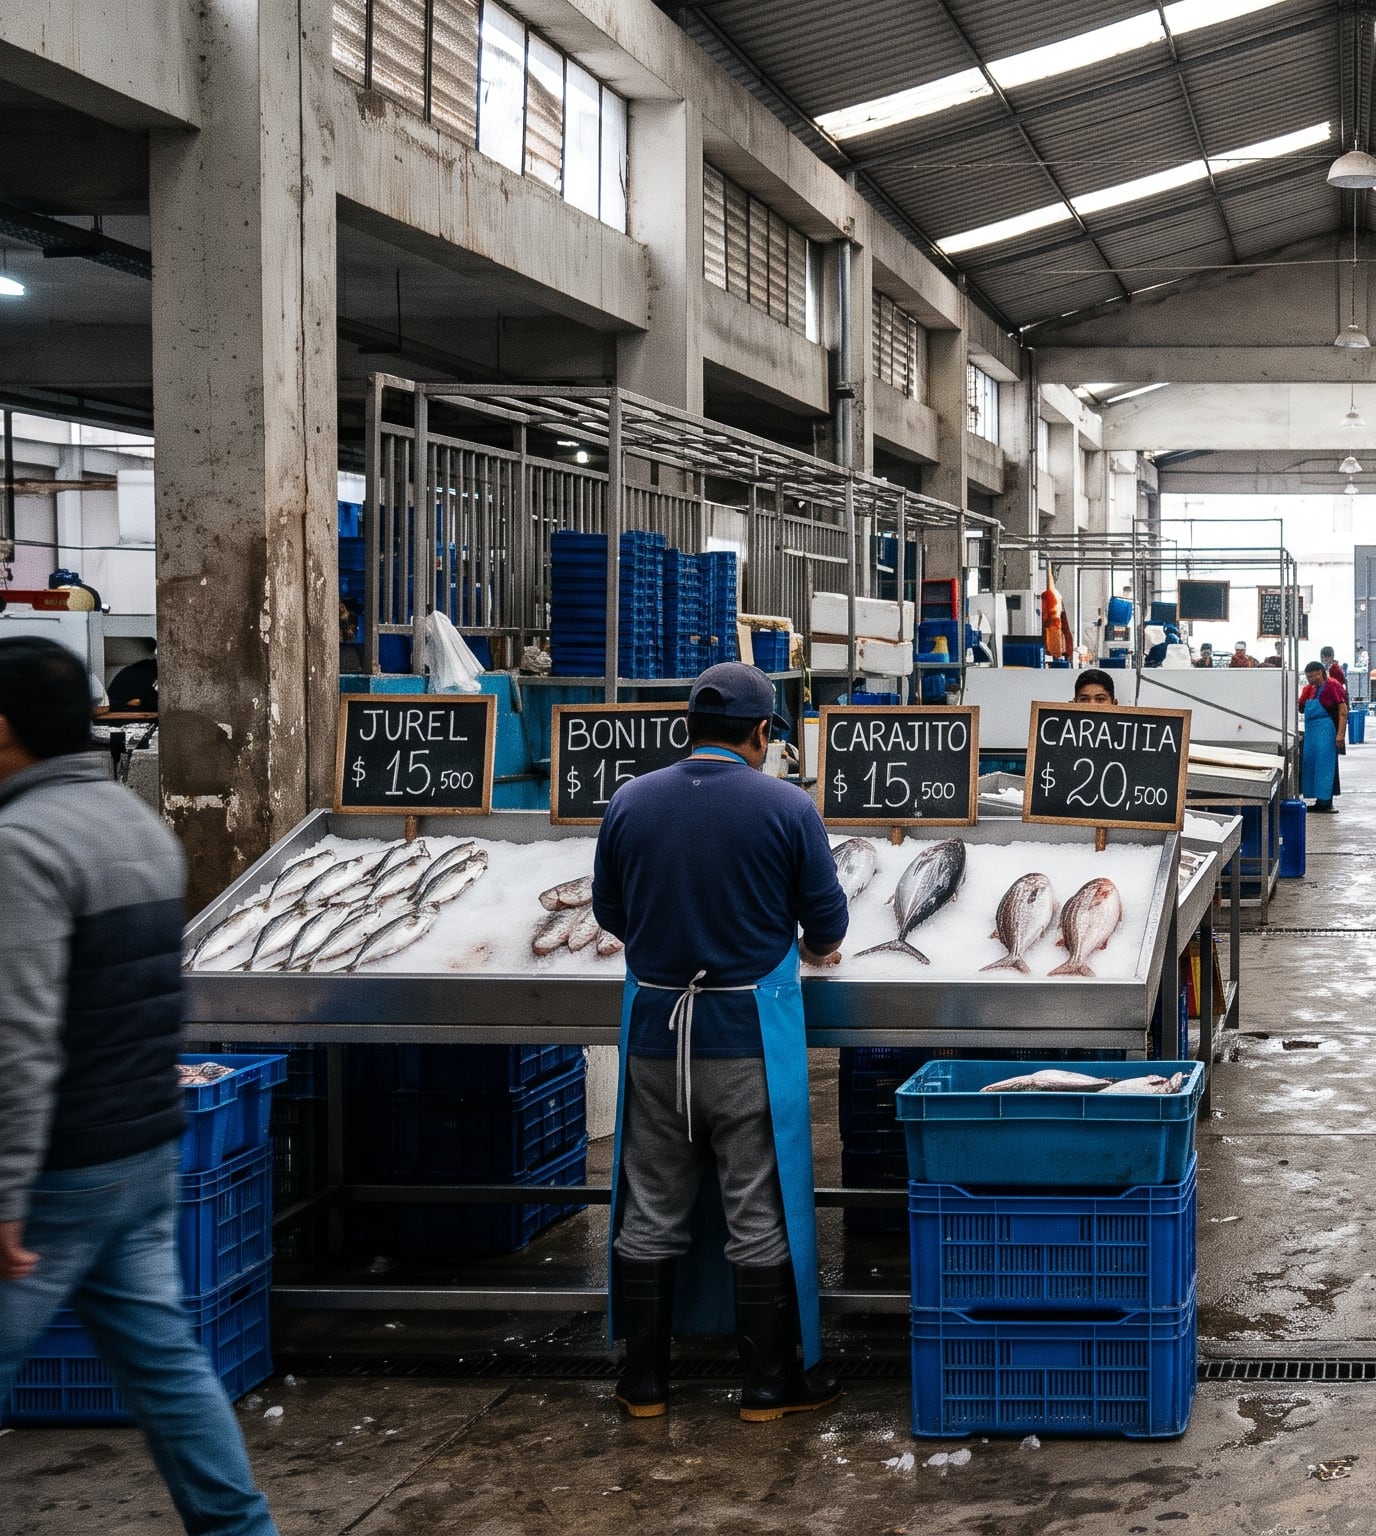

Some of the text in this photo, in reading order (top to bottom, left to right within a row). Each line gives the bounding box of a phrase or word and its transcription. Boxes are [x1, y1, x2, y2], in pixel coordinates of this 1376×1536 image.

[360, 710, 467, 741] JUREL
[568, 717, 688, 751] BONITO
[831, 721, 966, 751] CARAJITO
[352, 750, 473, 796] $ 15,500
[567, 766, 581, 799] $
[833, 762, 955, 808] $ 15,500
[1040, 758, 1167, 811] $ 20,500
